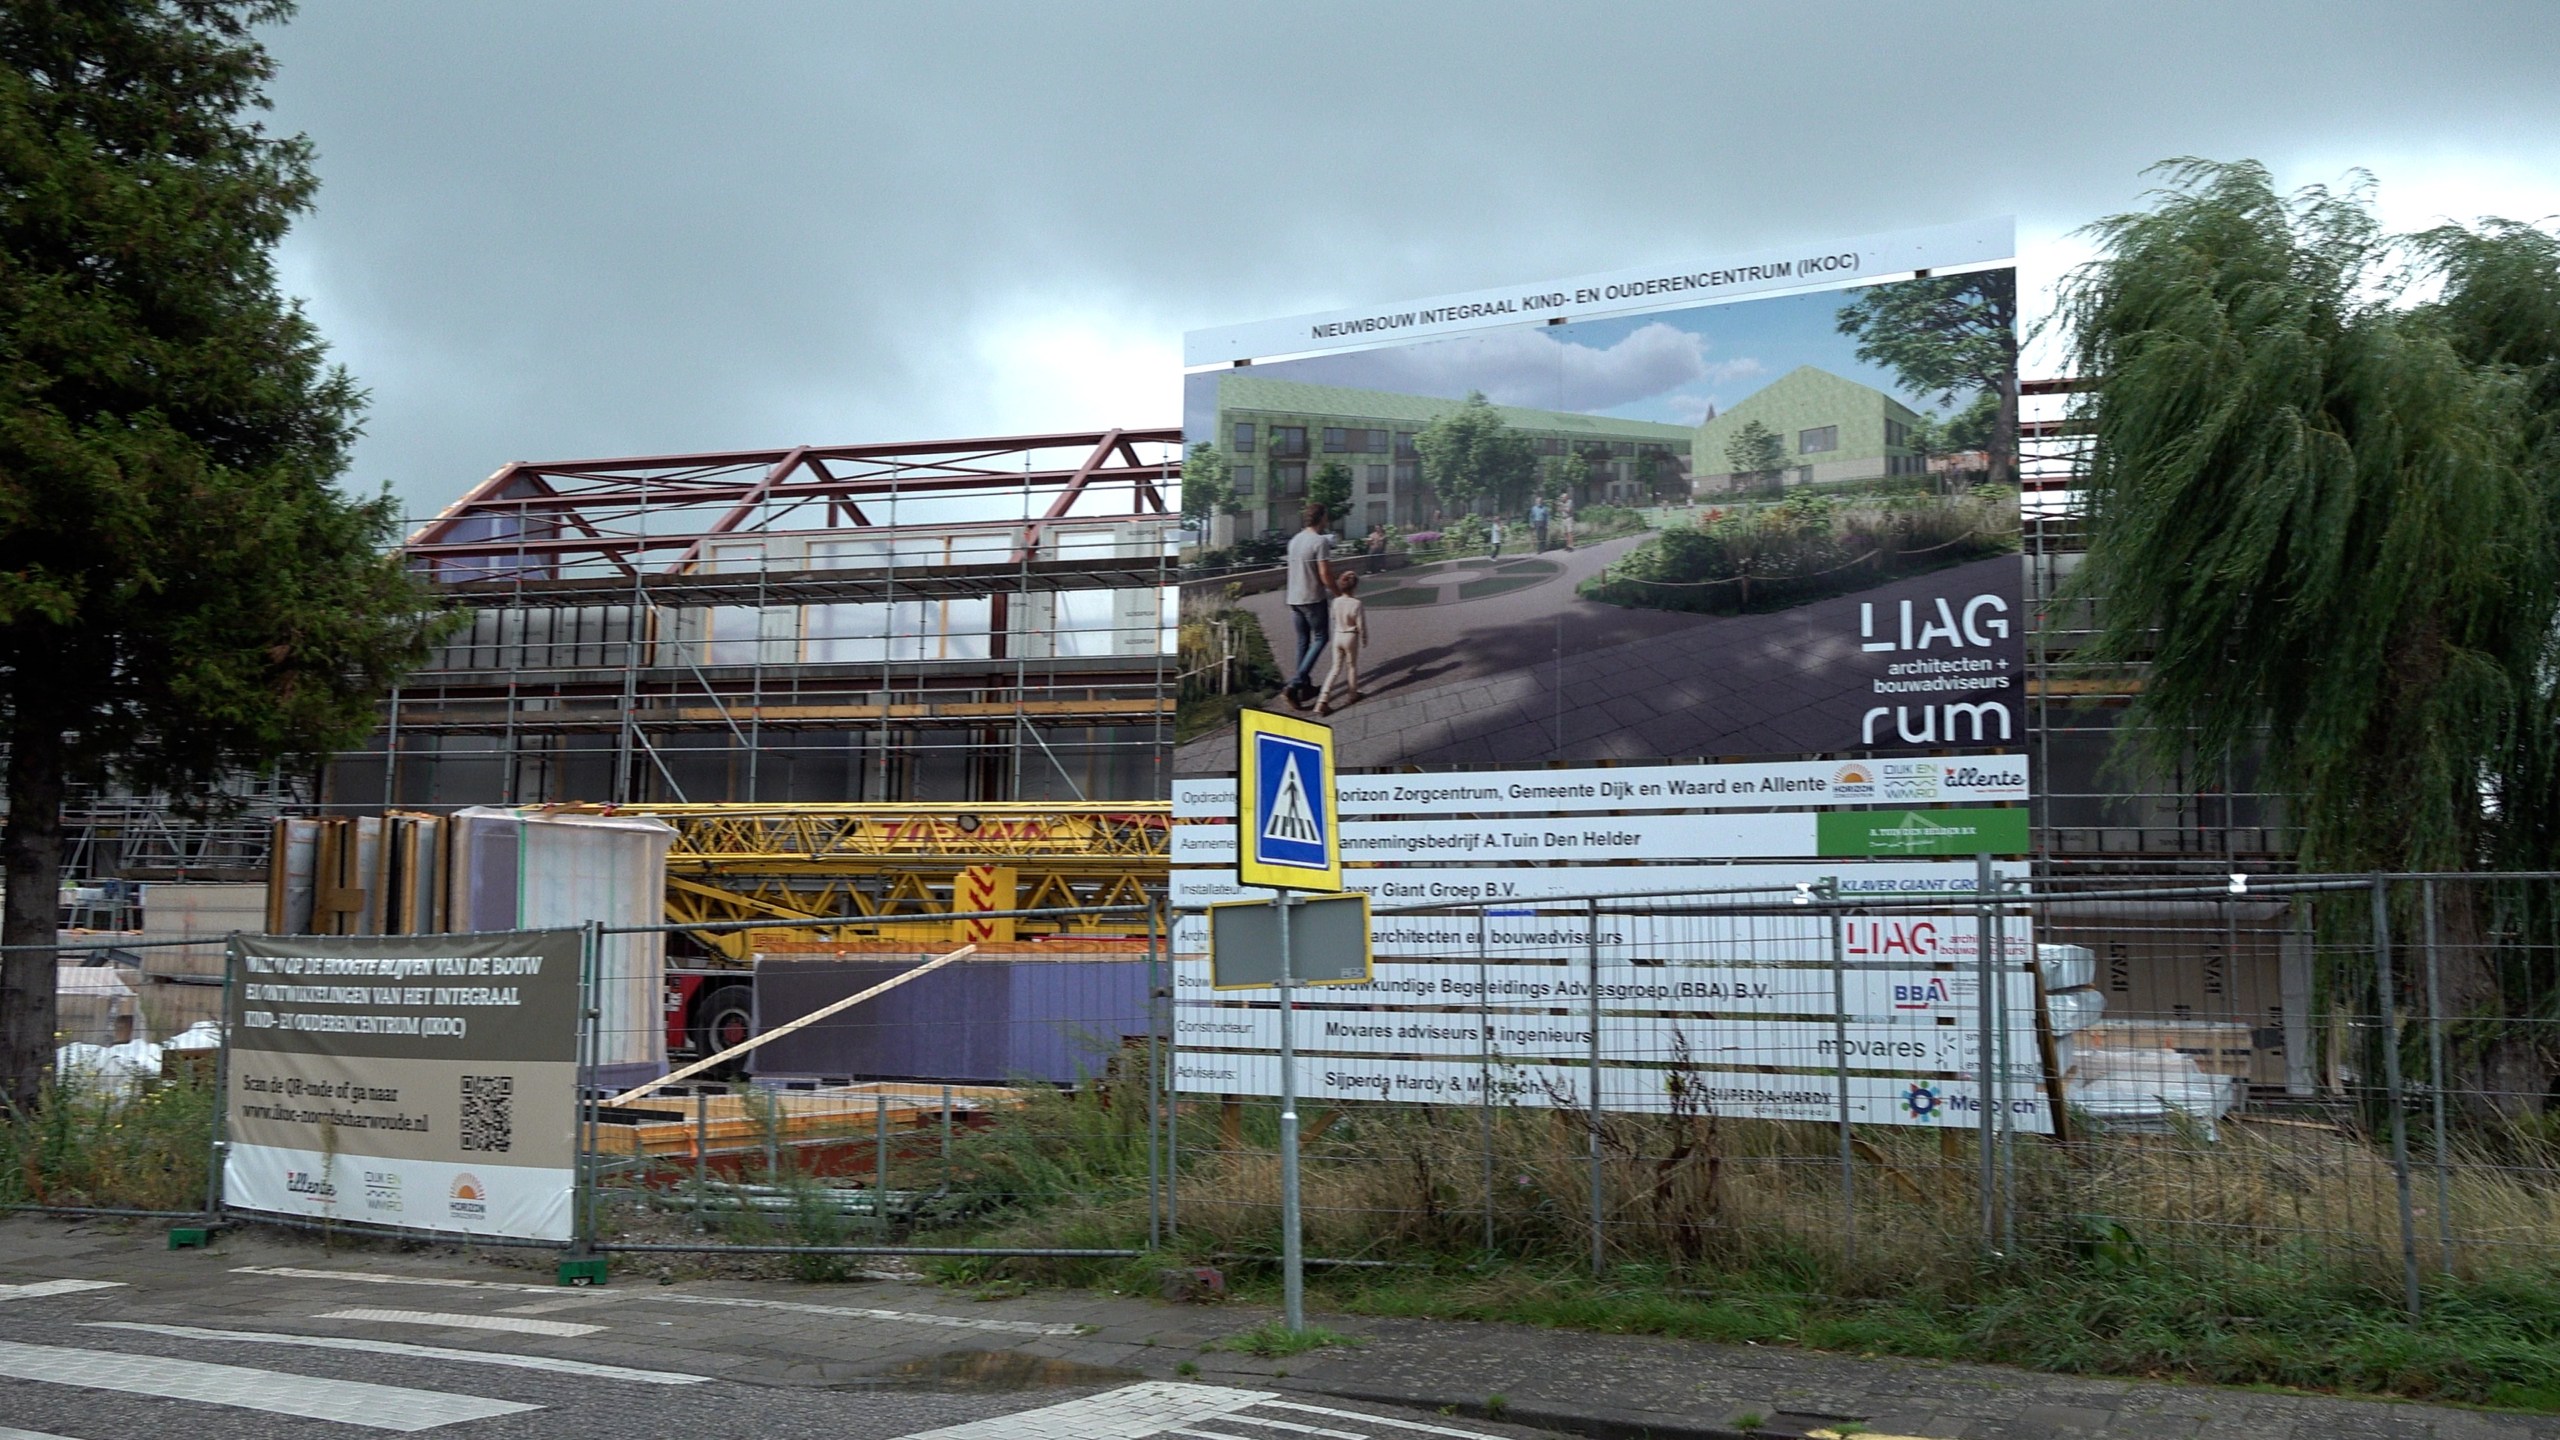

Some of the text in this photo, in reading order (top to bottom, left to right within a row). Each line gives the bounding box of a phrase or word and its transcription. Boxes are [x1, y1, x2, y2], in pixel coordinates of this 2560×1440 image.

[1312, 252, 1860, 339] NIEUWBOUW INTEGRAAL KIND- EN OUDERENCENTRUM (IKOC)
[1860, 594, 2009, 652] LIAG
[1888, 658, 1992, 676] architecten
[1873, 674, 2010, 694] bouwadviseurs
[1862, 701, 2011, 744] rum
[1916, 763, 1938, 774] EN
[1393, 786, 1504, 804] Zorgcentrum,
[1508, 783, 1595, 800] Gemeente
[1600, 781, 1634, 800] Dijk
[1640, 783, 1661, 796] en
[1667, 778, 1726, 796] Waard
[1732, 781, 1754, 794] en
[1760, 776, 1826, 793] Allente
[1339, 834, 1480, 852] annemingsbedrijf
[1544, 832, 1578, 847] Den
[1583, 830, 1641, 847] Helder
[1382, 882, 1425, 897] Giant
[1430, 882, 1480, 900] Groep
[1485, 882, 1521, 898] B.V.
[1841, 880, 1897, 891] KLAVER
[1900, 879, 1948, 890] GIANT
[1371, 929, 1461, 944] architecten
[1848, 922, 1937, 955] LIAG
[304, 957, 323, 975] DE
[323, 958, 379, 976] HOOGTE
[377, 958, 435, 980] BLIJVEN
[436, 958, 467, 976] VAN
[468, 957, 490, 976] DE
[492, 956, 543, 975] BOUW
[372, 986, 402, 1005] VAN
[403, 987, 433, 1005] HET
[434, 987, 521, 1006] INTEGRAAL
[1555, 980, 1669, 1000] Advesgroep
[1674, 982, 1728, 1001] (BBA)
[1735, 983, 1773, 999] B.V.
[1894, 985, 1940, 1001] BBA
[244, 1010, 278, 1029] KIND-
[294, 1013, 420, 1035] OUDERENCENTRUM
[421, 1017, 467, 1039] (IKOC)
[1325, 1022, 1392, 1038] Movares
[1397, 1024, 1478, 1040] adviseurs
[1500, 1026, 1593, 1045] ingenieurs
[1817, 1038, 1927, 1057] movares
[243, 1074, 267, 1092] Scan
[270, 1076, 283, 1094] de
[335, 1081, 350, 1099] of
[351, 1087, 367, 1104] ga
[368, 1088, 399, 1102] naar
[1325, 1072, 1390, 1090] Sijperda
[1396, 1074, 1444, 1094] Hardy
[1450, 1076, 1462, 1091] &
